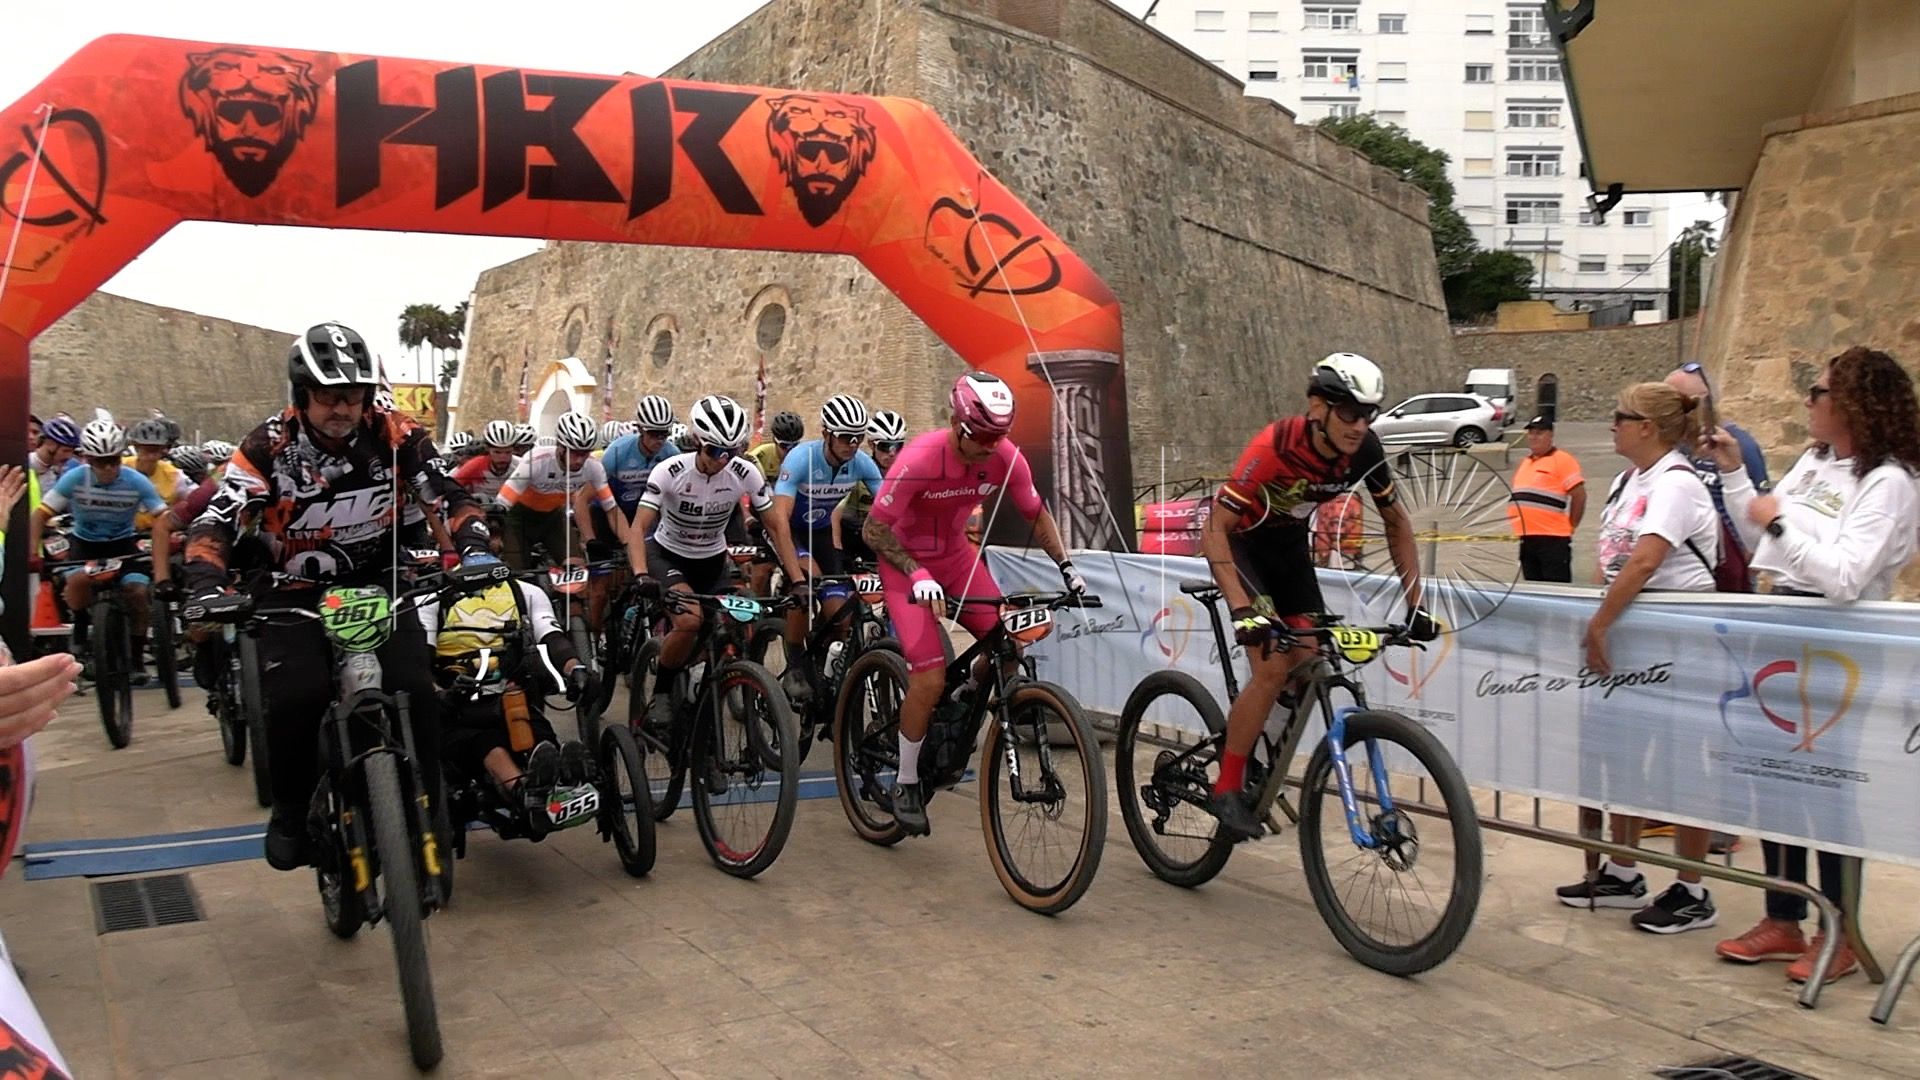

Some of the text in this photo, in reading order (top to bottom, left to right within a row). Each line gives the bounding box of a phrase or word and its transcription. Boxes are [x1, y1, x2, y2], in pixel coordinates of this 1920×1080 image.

[335, 59, 765, 221] HBR
[922, 487, 976, 499] fundación
[555, 570, 584, 585] 108
[1007, 610, 1047, 632] 138
[1475, 662, 1674, 700] Ceuta es Deporte
[555, 793, 597, 822] 055
